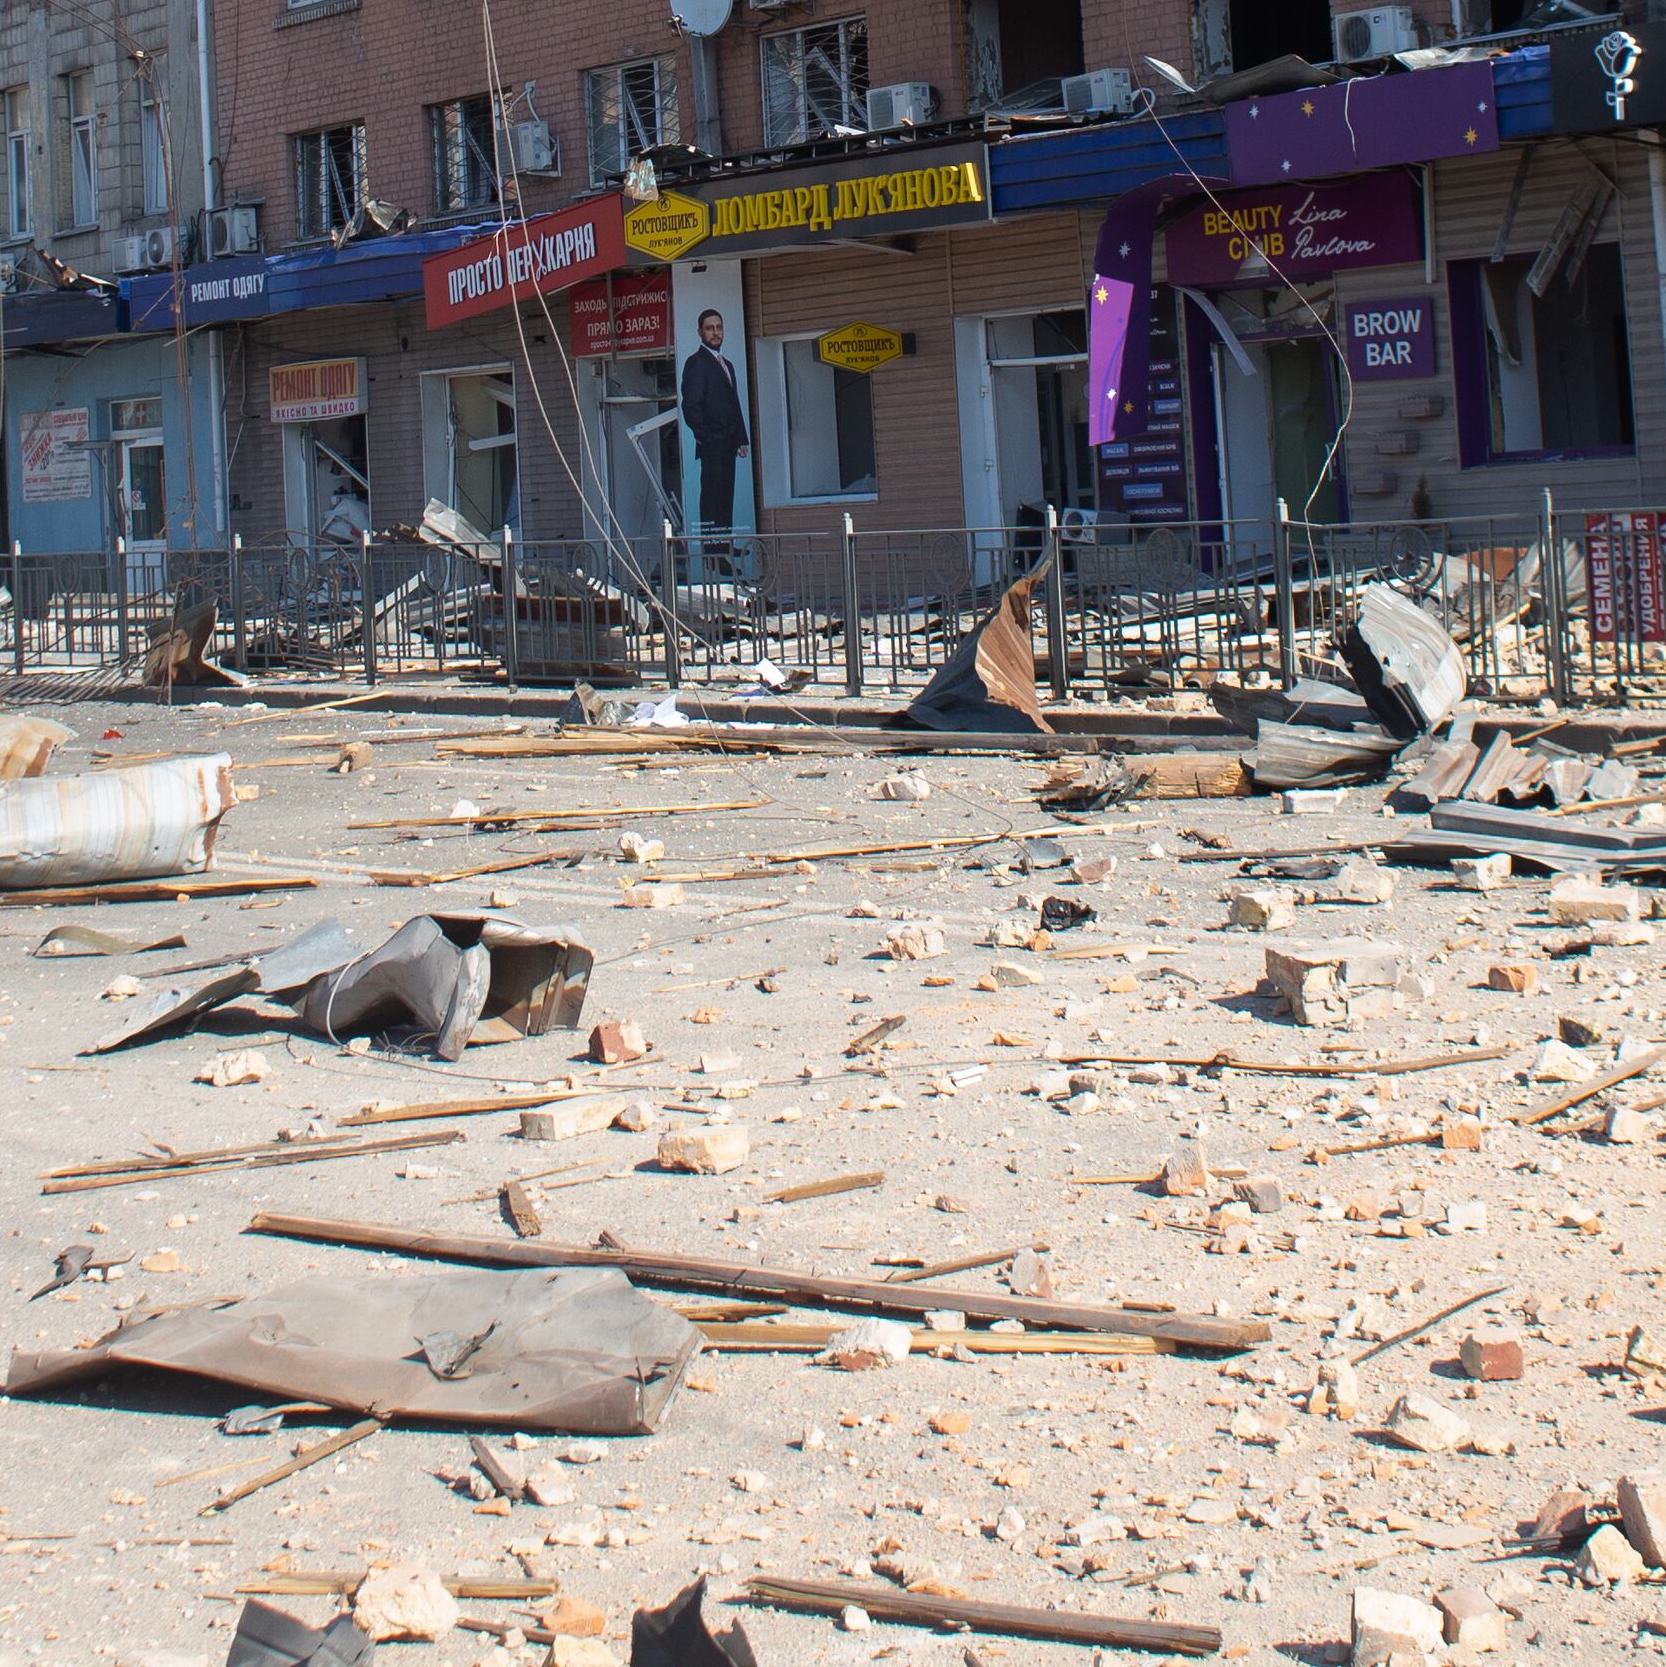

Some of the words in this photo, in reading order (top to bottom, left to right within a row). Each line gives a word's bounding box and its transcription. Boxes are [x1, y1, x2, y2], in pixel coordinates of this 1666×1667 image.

[632, 212, 699, 235] РОСТОВЩИКЪ
[712, 184, 833, 238] ЛОМБАРД
[1204, 205, 1283, 235] BEAUTY
[1290, 226, 1376, 260] Pavlova
[191, 278, 231, 303] РЕМОНТ
[233, 273, 266, 299] ОДЯГУ
[448, 255, 503, 306] ПРОСТО
[574, 299, 607, 313] ЗАХОДЬ
[613, 290, 670, 310] ПІДСТРИЖИС
[625, 315, 661, 333] ЗАРАЗ!
[1353, 309, 1422, 337] BROW
[826, 337, 896, 354] РОСТОВЩИКЪ
[1366, 340, 1413, 367] BAR
[271, 368, 318, 403] РЕМОНТ
[320, 361, 356, 400] ОДЯГУ
[275, 407, 307, 419] ЯКІСНО
[309, 405, 318, 416] ТА
[320, 402, 355, 415] ШВИДКО
[1590, 522, 1614, 633] СЕМЕНА
[1635, 518, 1654, 633] УДОБРЕНИЯ
